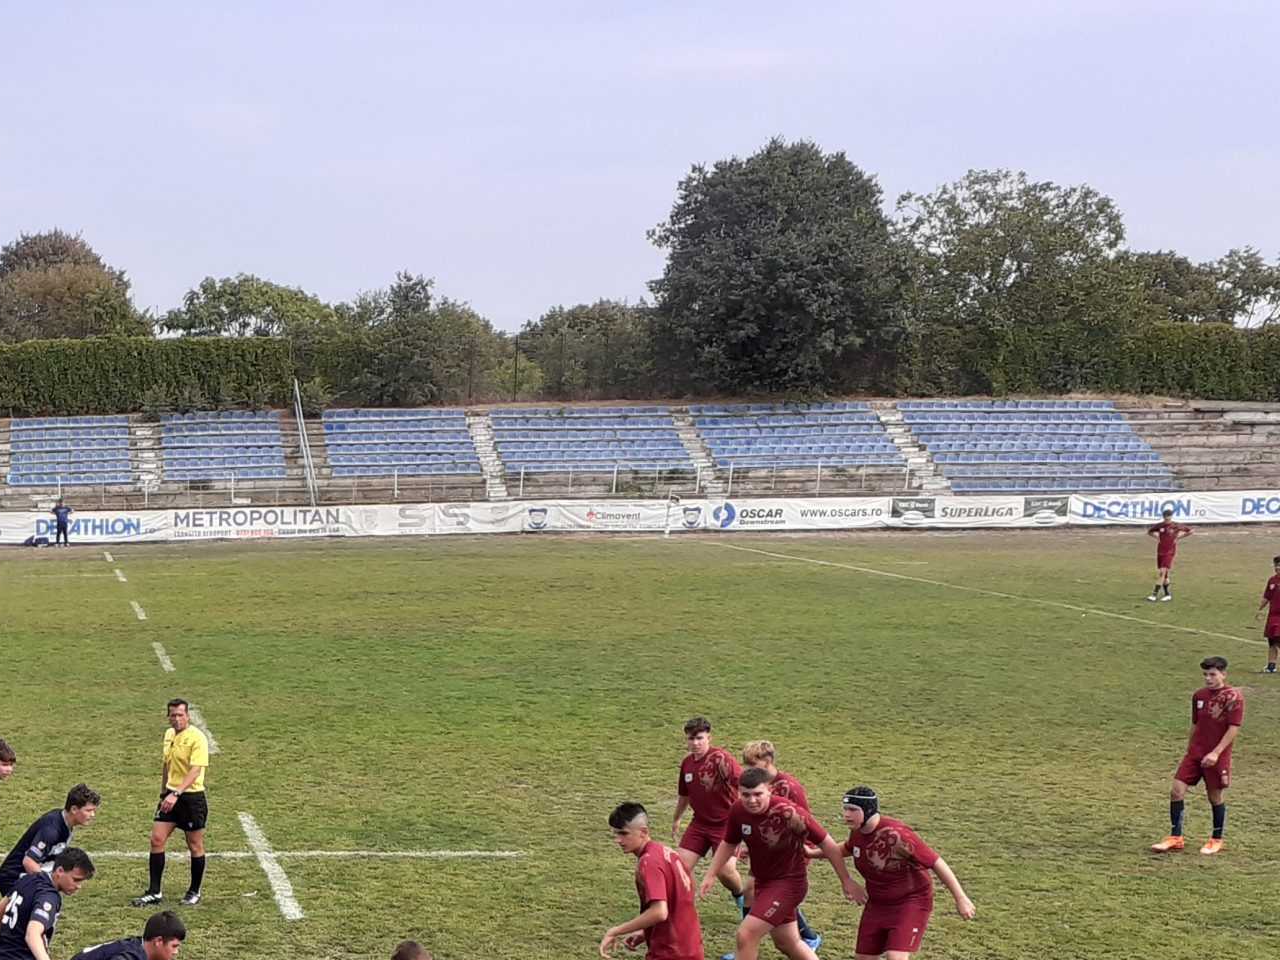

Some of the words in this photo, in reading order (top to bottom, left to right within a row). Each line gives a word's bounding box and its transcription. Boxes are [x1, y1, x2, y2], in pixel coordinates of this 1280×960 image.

[174, 508, 340, 528] METROPOLITAN
[594, 511, 641, 520] Climavent
[739, 508, 784, 519] OSCAR
[800, 507, 883, 518] www.oscars.ro
[739, 518, 787, 526] Downstream
